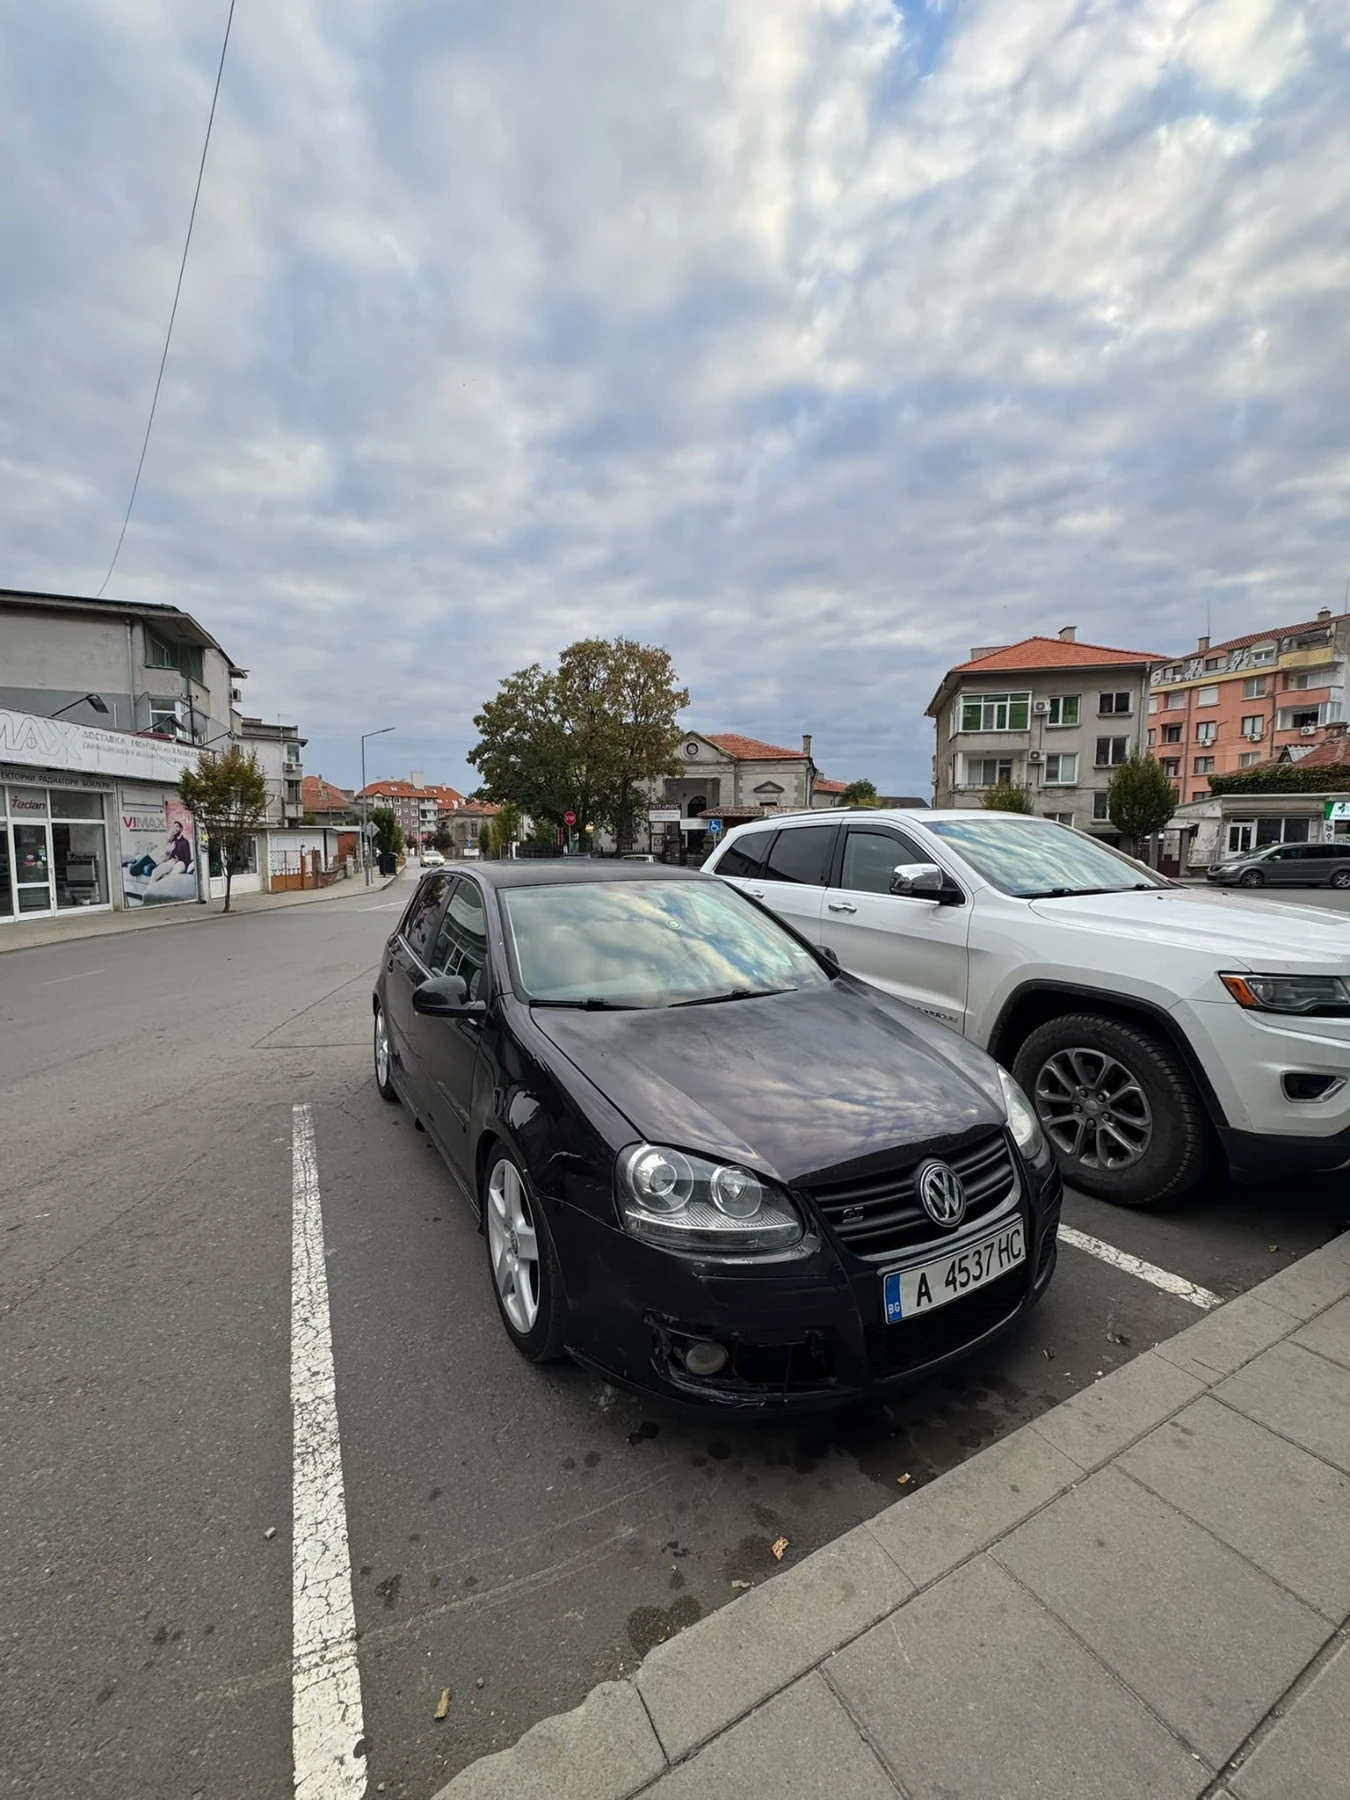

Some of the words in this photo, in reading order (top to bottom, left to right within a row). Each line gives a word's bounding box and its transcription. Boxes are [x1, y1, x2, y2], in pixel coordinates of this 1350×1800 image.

[83, 730, 125, 745] ДОСТАВКА
[39, 775, 79, 786] РАДИАТОРИ
[123, 816, 165, 829] VIMAX
[916, 1272, 933, 1307] A
[945, 1241, 995, 1292] 4537
[888, 1302, 901, 1315] BG
